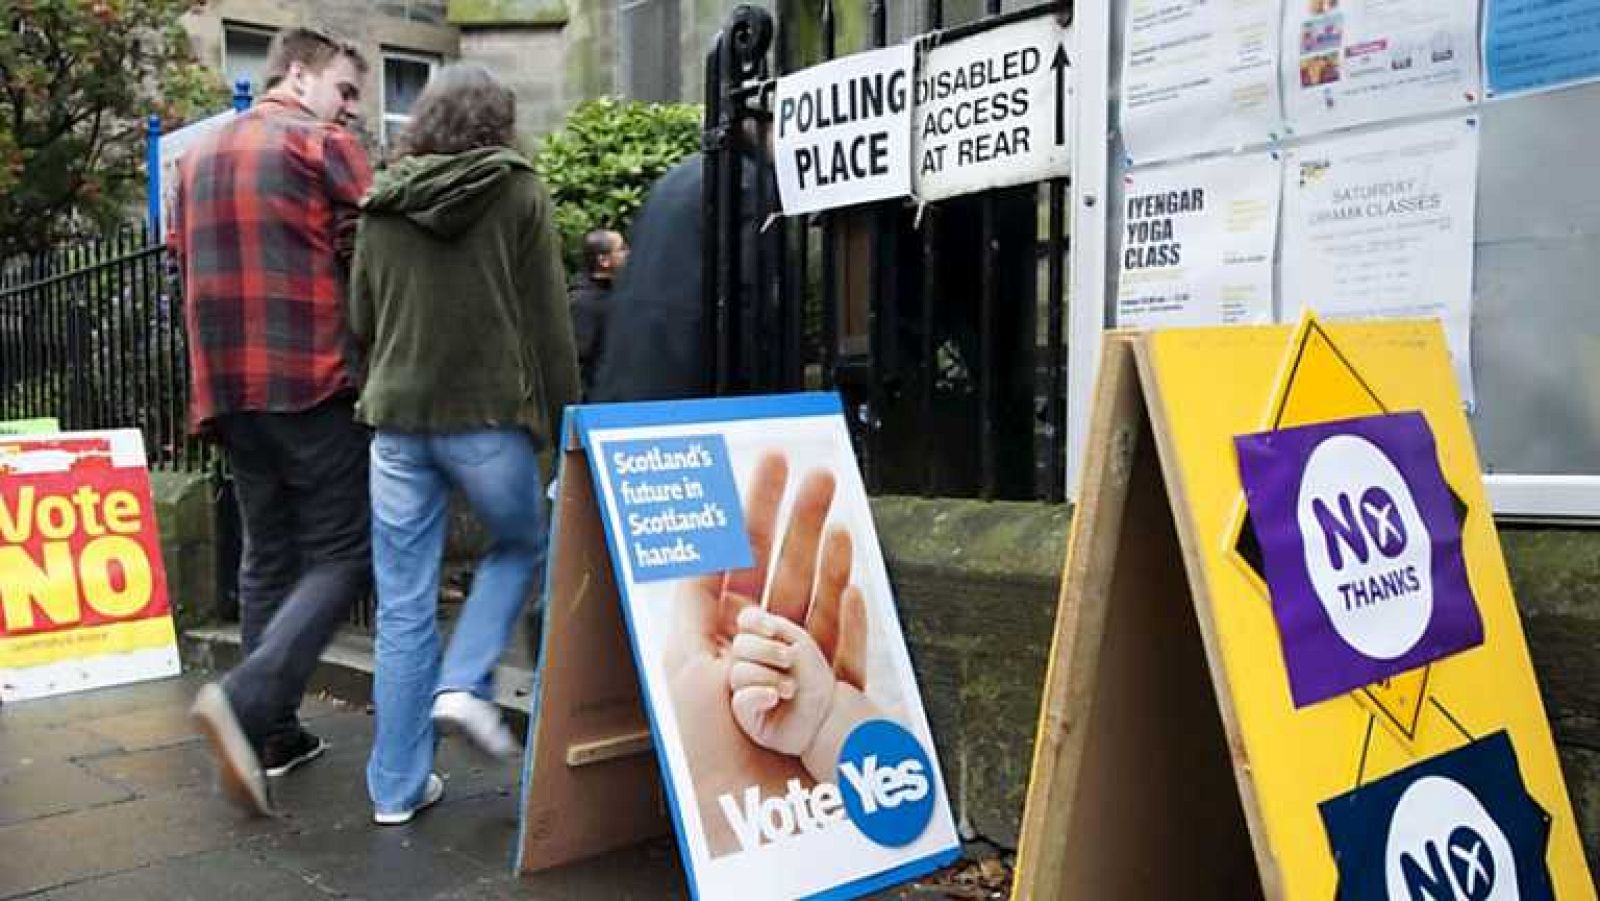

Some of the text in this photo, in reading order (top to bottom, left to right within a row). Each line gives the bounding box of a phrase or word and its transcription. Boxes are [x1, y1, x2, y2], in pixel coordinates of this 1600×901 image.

[779, 68, 907, 138] POLLING
[916, 47, 1040, 104] DISABLED
[923, 87, 1030, 140] ACCESS
[794, 131, 889, 190] PLACE
[921, 126, 1031, 176] AT REAR
[1127, 218, 1174, 244] YOGA
[1128, 187, 1204, 220] IYENGAR
[1124, 243, 1181, 270] CLASS
[0, 485, 141, 543] Vote
[621, 476, 704, 506] future in
[1312, 486, 1408, 571] NO
[0, 535, 152, 630] NO
[1337, 566, 1421, 611] THANKS
[718, 754, 929, 850] Vote Yes
[1400, 825, 1497, 901] NO
